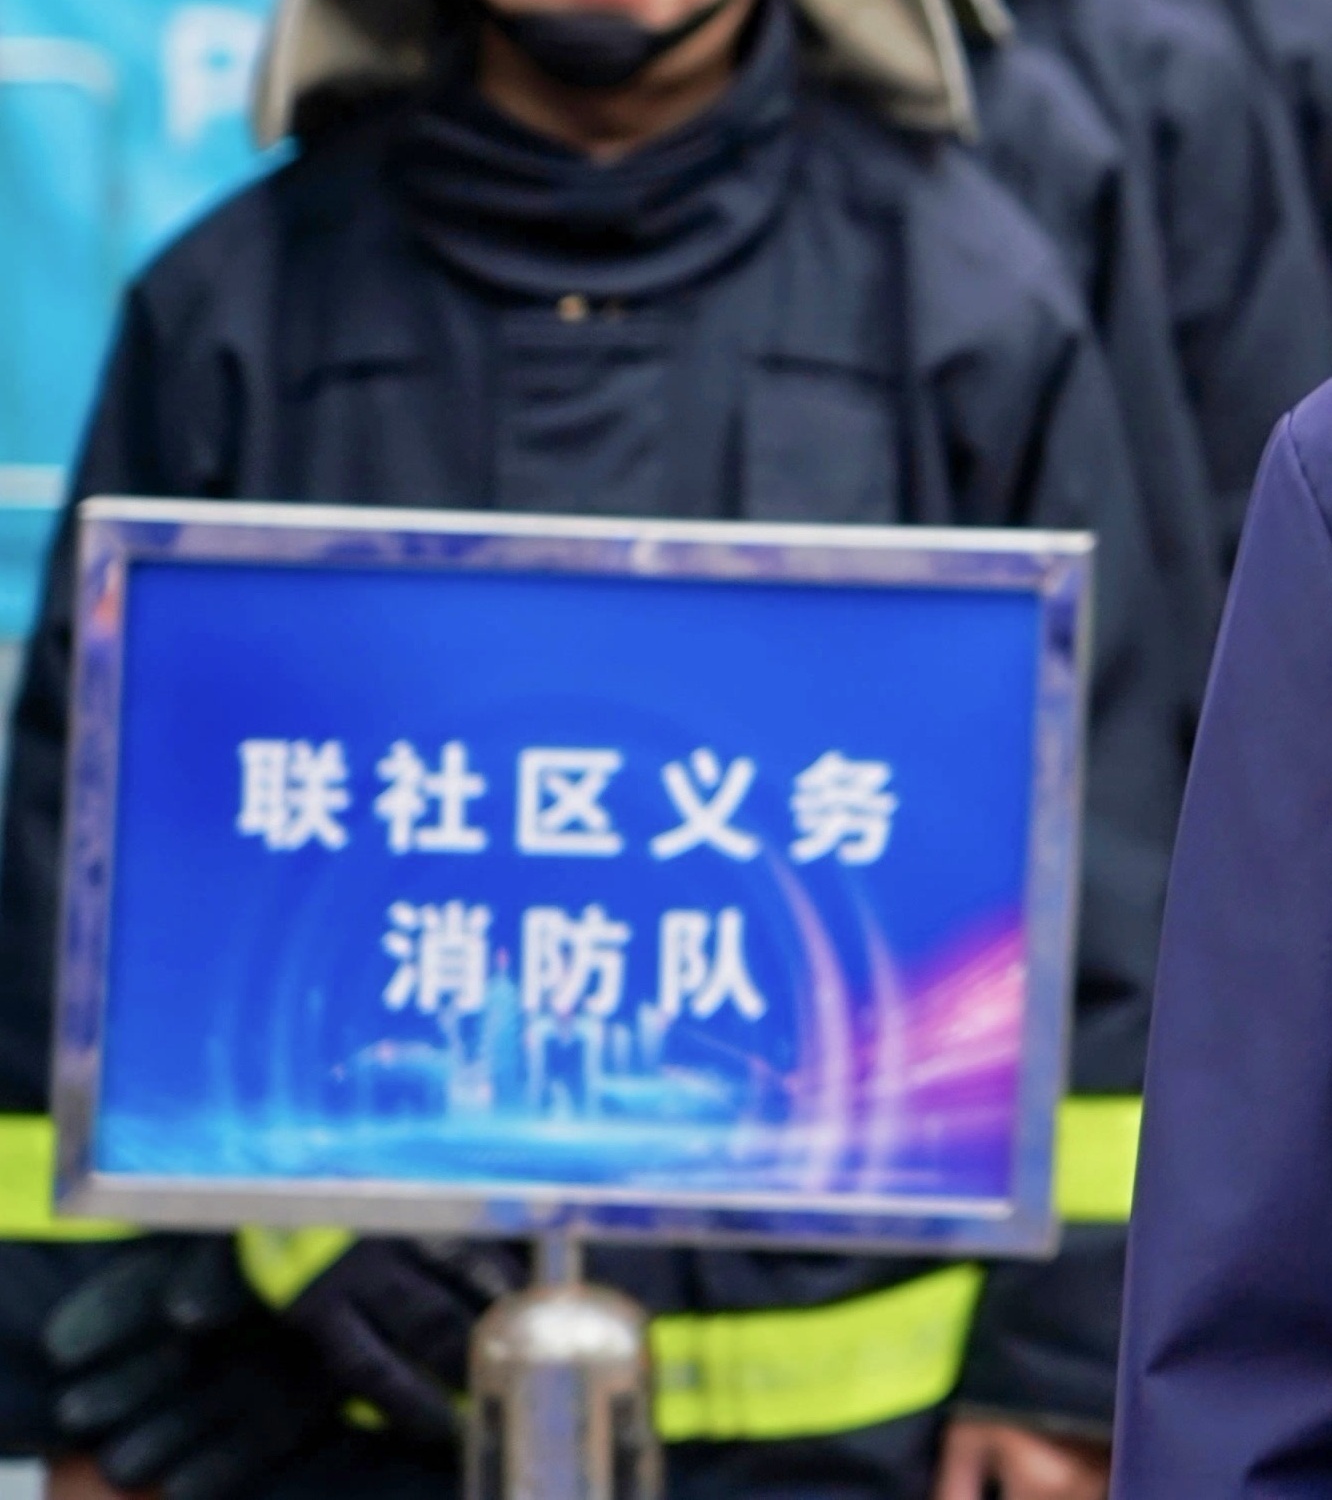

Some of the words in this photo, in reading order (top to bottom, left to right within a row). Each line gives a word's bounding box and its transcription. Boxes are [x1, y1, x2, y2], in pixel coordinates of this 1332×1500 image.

[237, 740, 898, 864] 联社区义务
[382, 900, 768, 1020] 消防队
